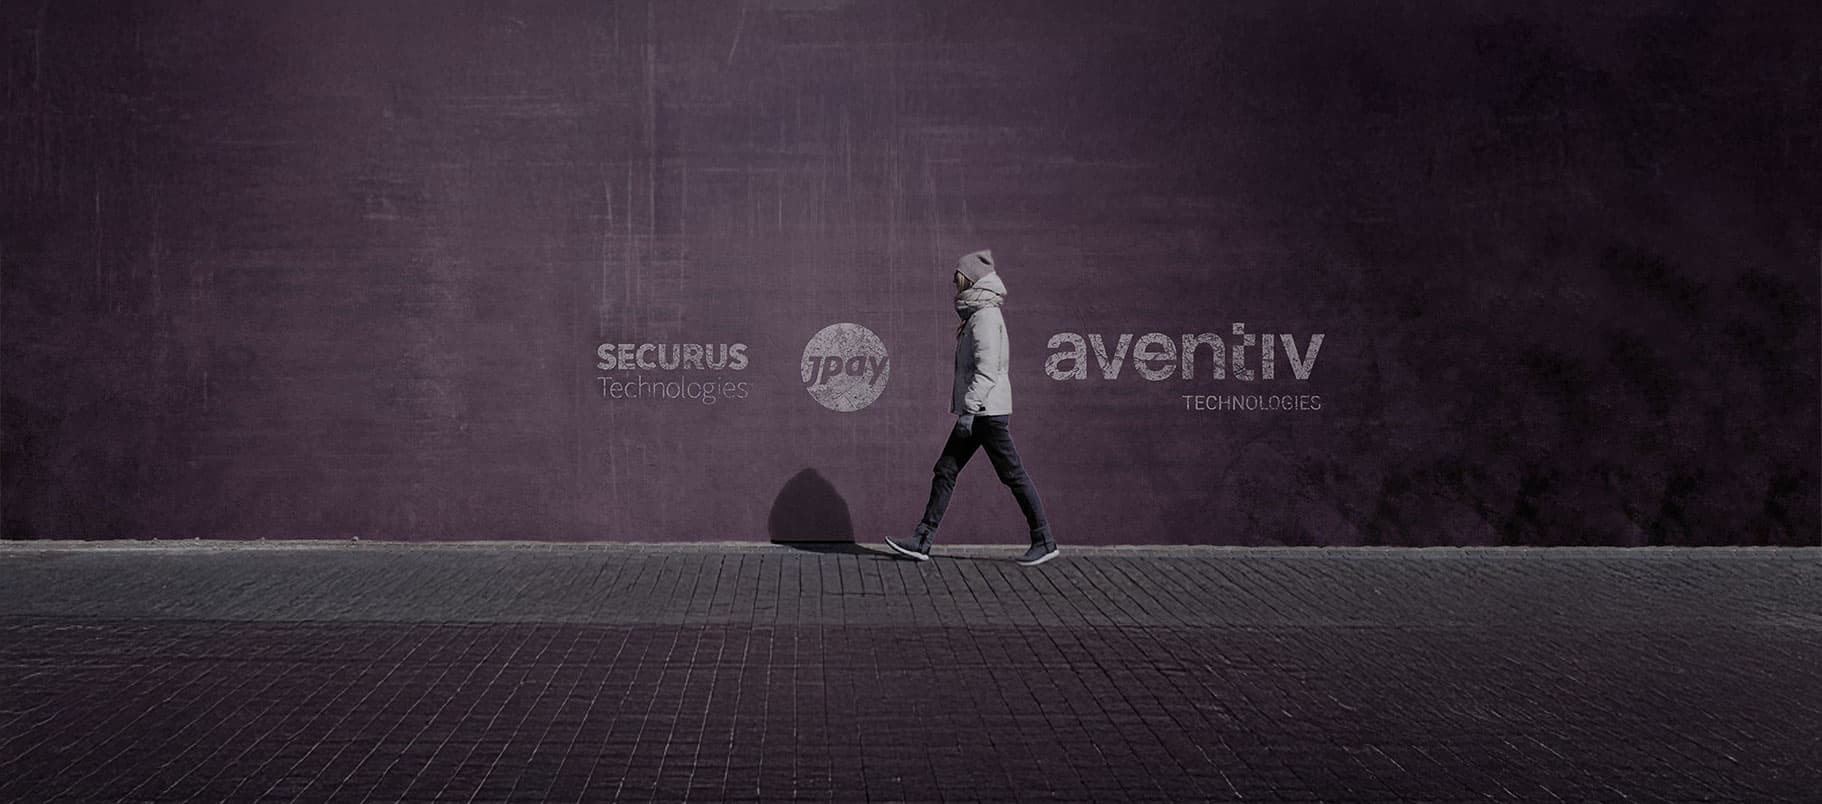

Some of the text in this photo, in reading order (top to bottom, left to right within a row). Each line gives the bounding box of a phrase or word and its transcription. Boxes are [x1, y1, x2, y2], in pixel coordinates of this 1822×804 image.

[597, 343, 749, 370] SECURUS
[1044, 322, 1325, 382] aventiv
[597, 376, 749, 405] Technologies
[1182, 395, 1321, 411] TECHNOLOGIES
